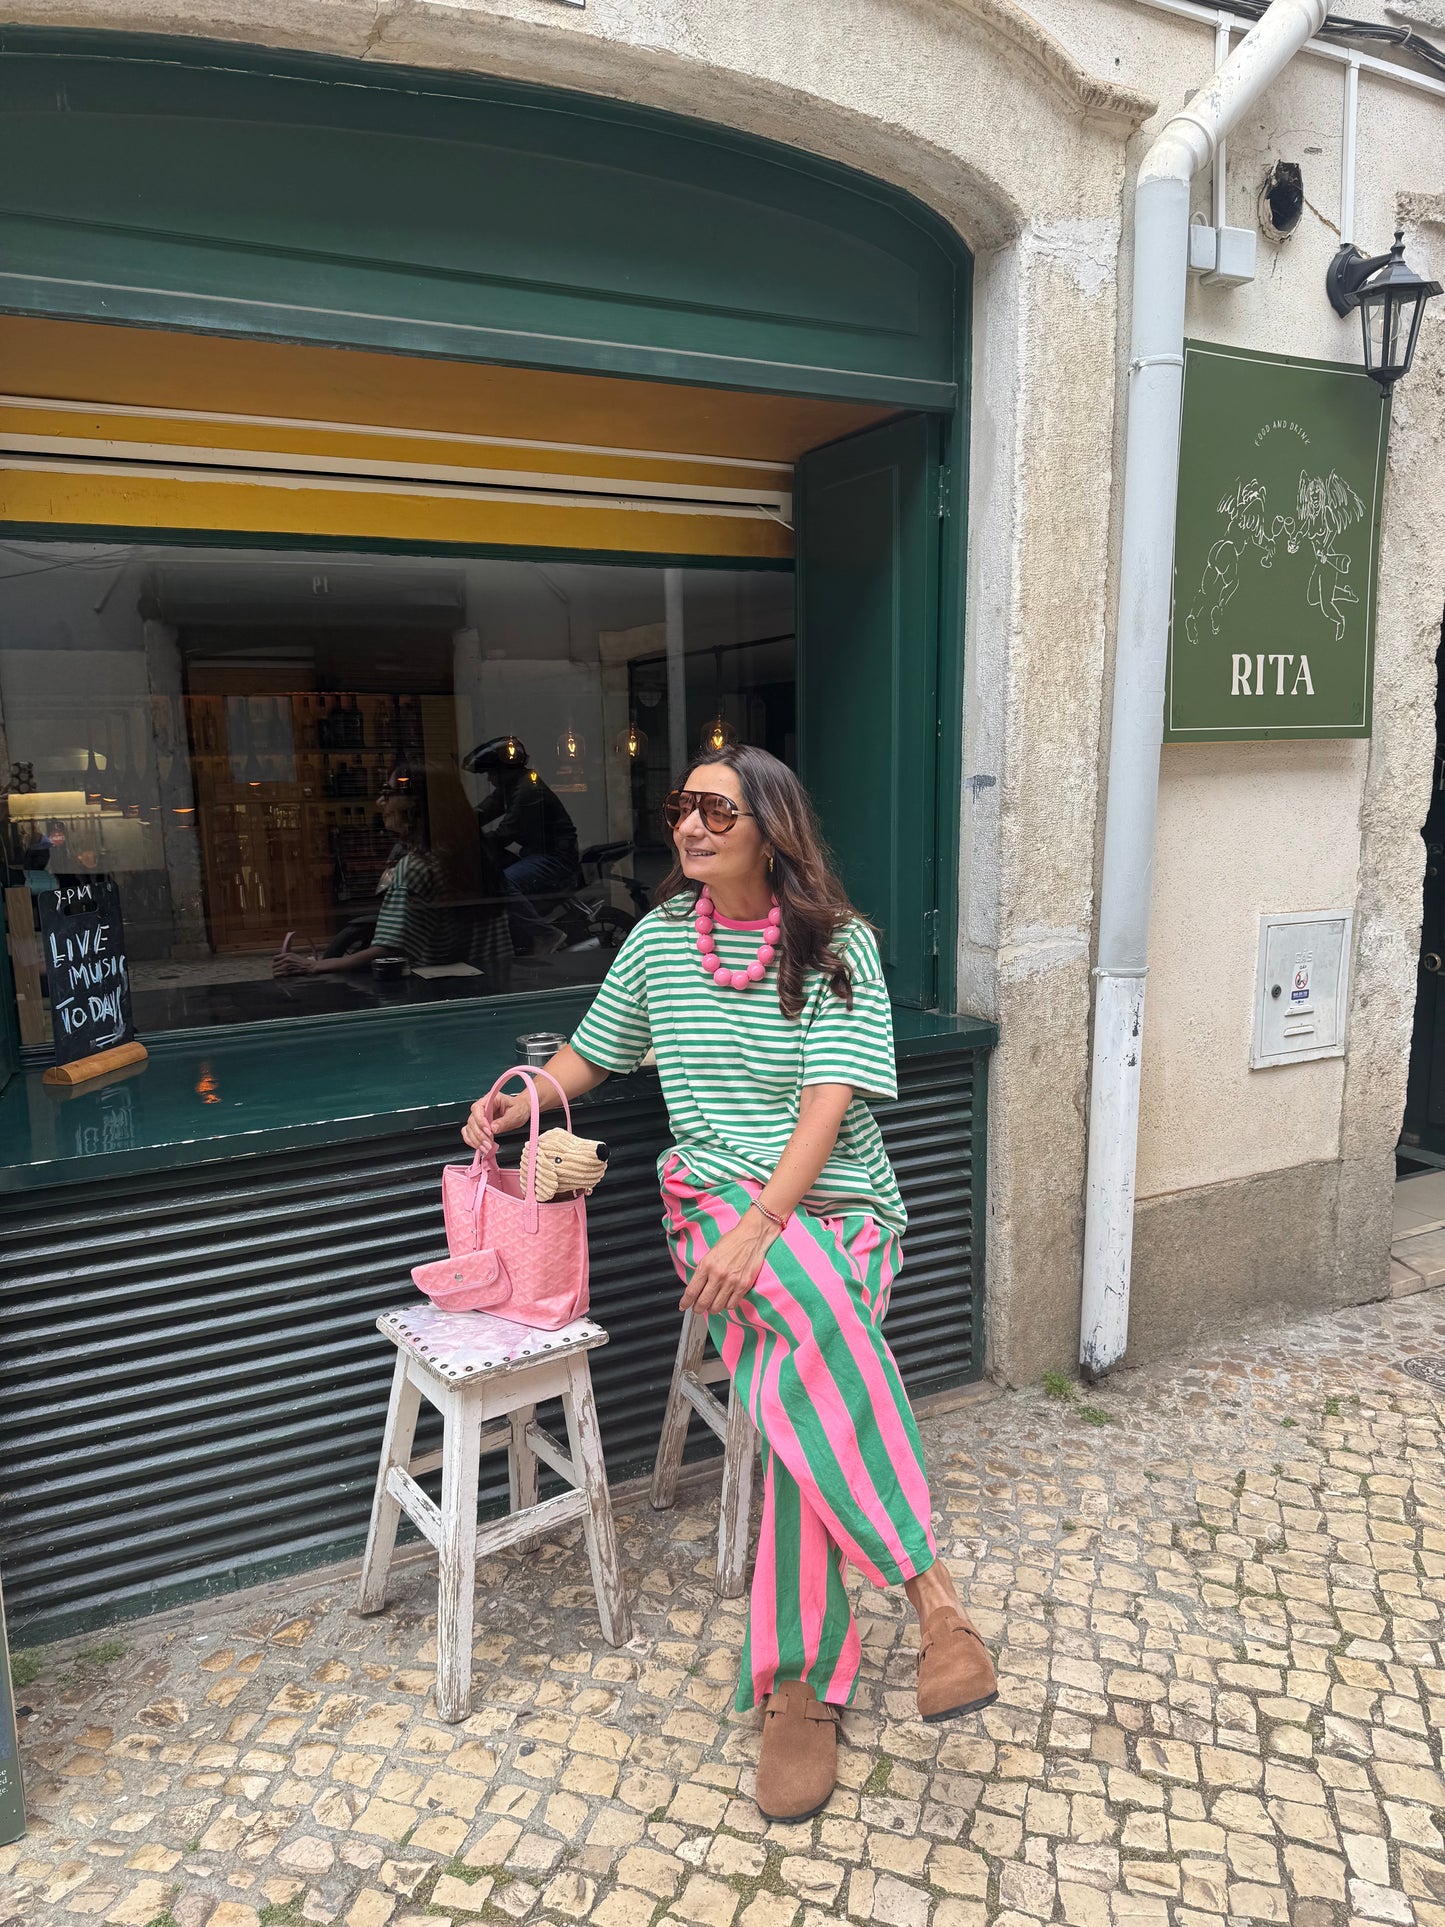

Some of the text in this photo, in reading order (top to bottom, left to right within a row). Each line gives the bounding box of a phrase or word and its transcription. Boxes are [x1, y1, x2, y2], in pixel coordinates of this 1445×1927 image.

[1255, 420, 1310, 446] FOOD AND DRINK
[1231, 653, 1315, 695] RITA
[50, 924, 110, 968] LIVE
[68, 955, 126, 990] MUSIC
